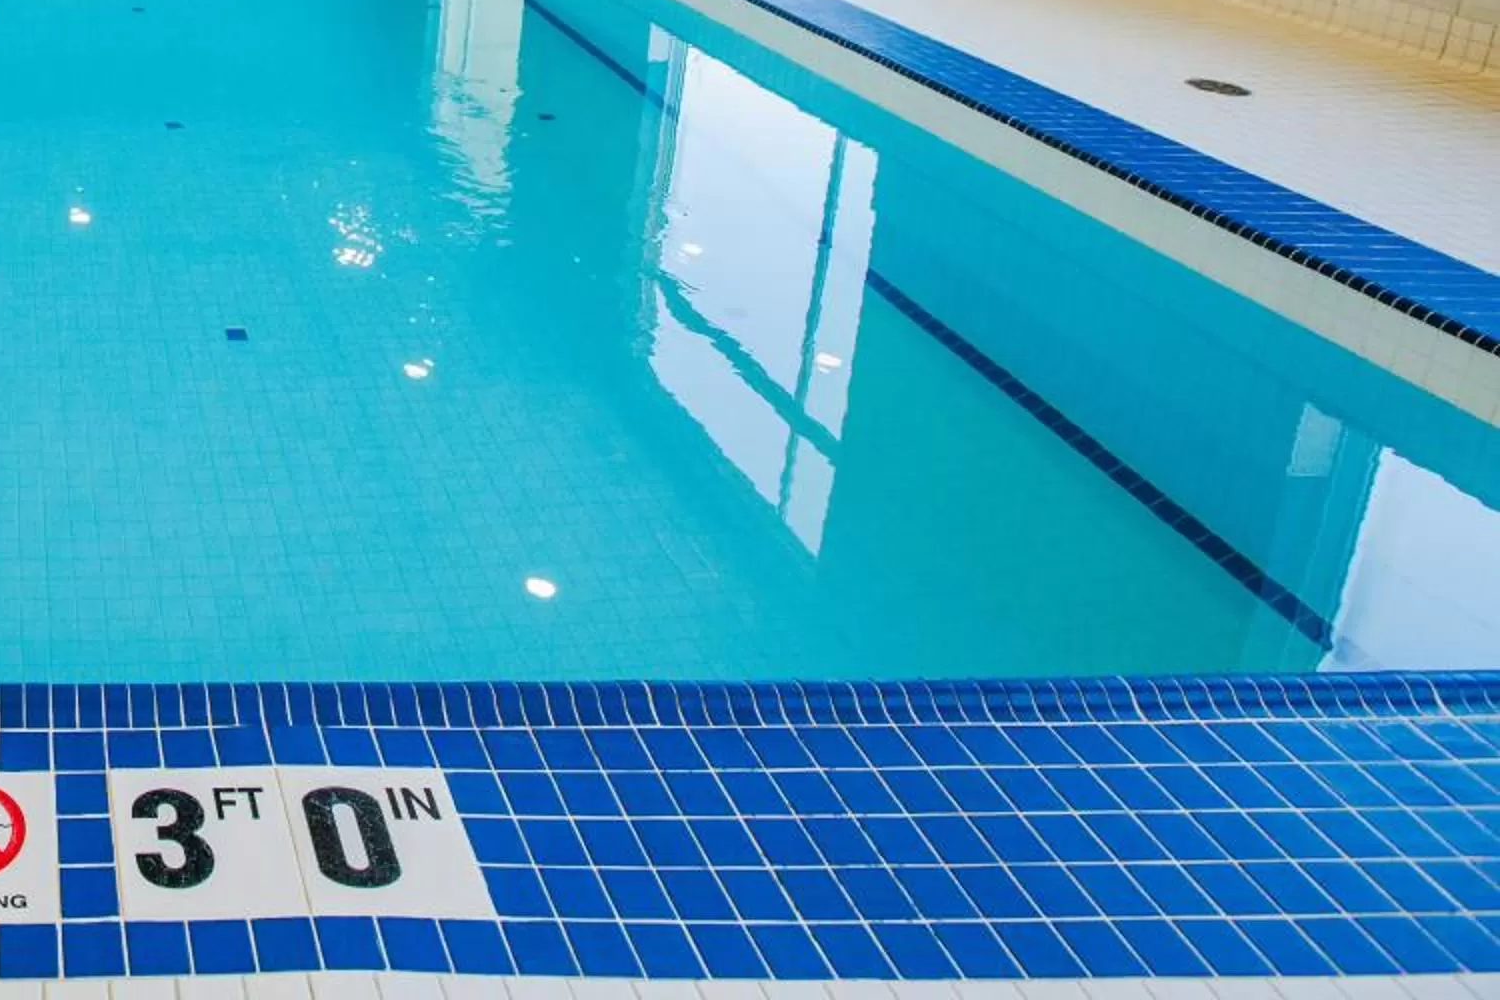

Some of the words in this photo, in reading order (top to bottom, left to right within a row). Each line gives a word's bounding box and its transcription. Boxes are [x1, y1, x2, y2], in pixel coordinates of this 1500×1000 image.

[131, 787, 215, 889] 3
[212, 787, 263, 820] FT
[302, 786, 402, 889] 0
[385, 787, 442, 821] IN
